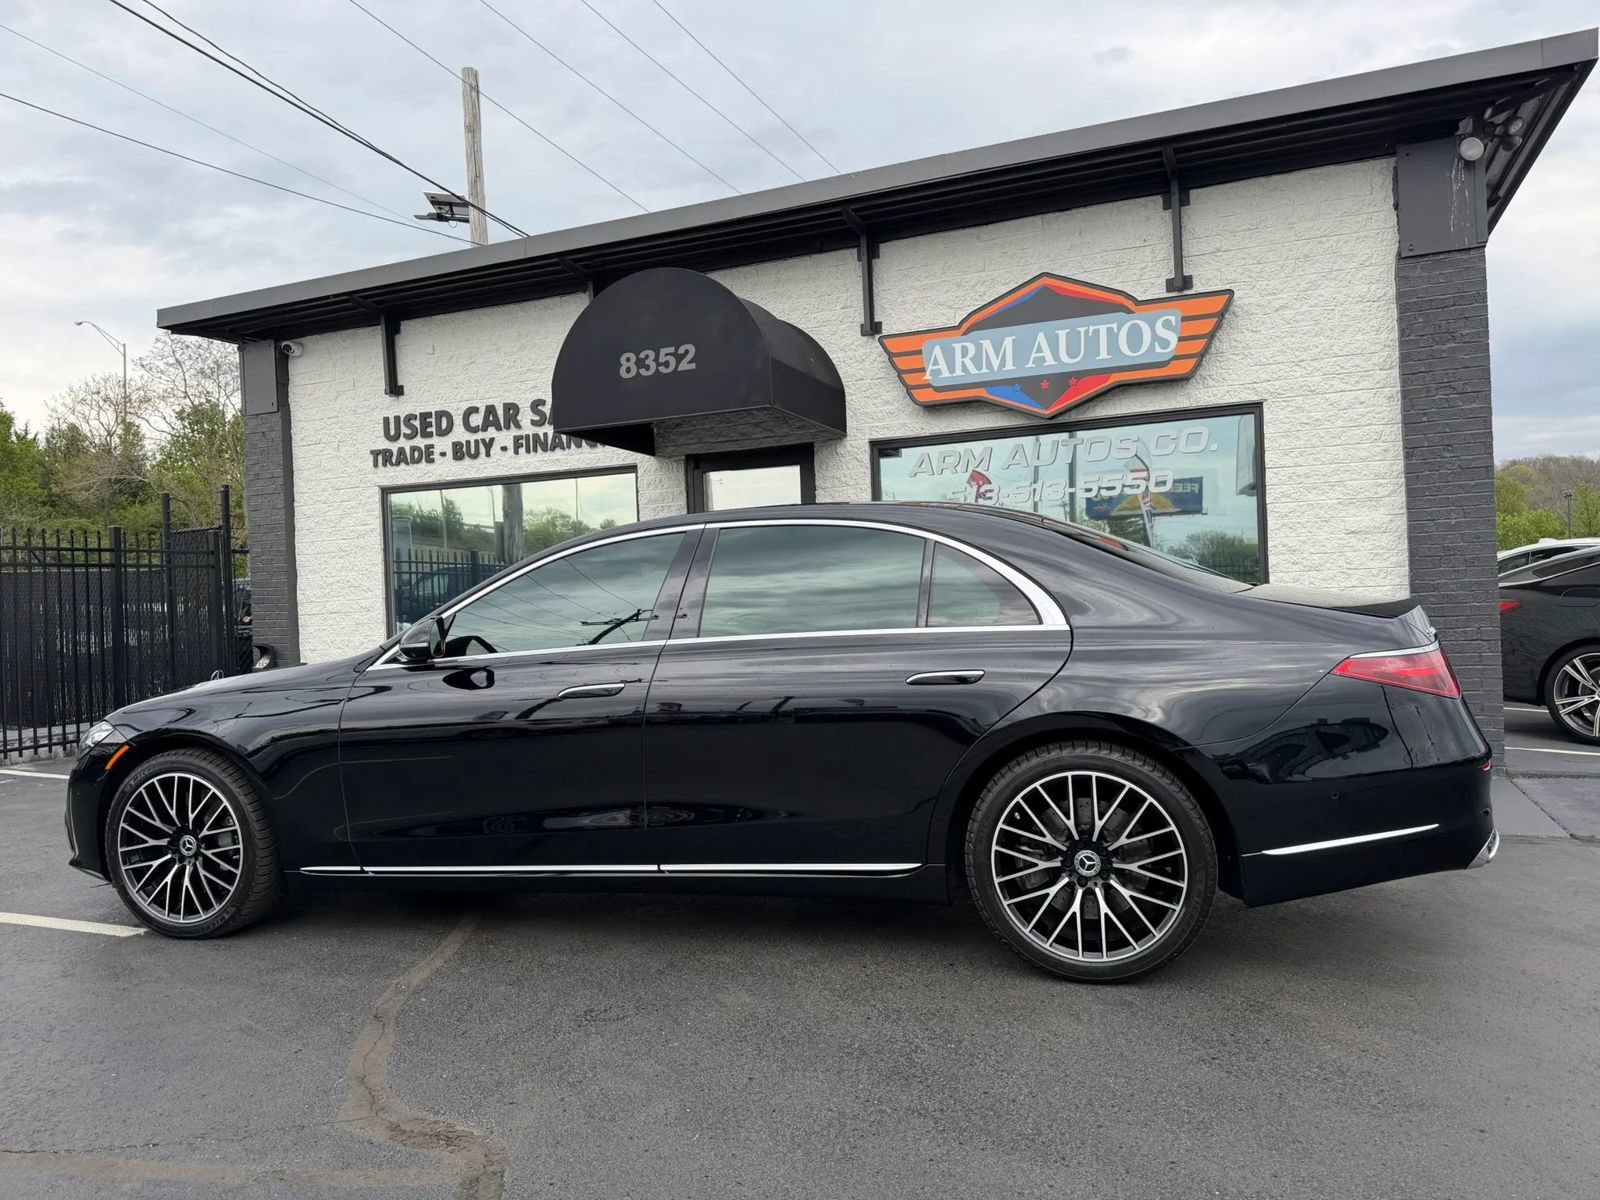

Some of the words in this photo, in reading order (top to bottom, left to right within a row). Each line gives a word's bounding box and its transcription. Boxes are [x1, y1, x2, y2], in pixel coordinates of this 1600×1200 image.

[619, 343, 697, 379] 8352
[922, 335, 1016, 380] ARM
[1028, 314, 1178, 369] AUTOS
[382, 410, 454, 442] USED
[462, 402, 522, 434] CAR
[530, 398, 554, 428] S
[369, 443, 435, 468] TRADE
[451, 437, 496, 461] BUY
[909, 447, 993, 477] ARM
[1001, 435, 1139, 471] AUTOS
[1150, 426, 1218, 456] CO.
